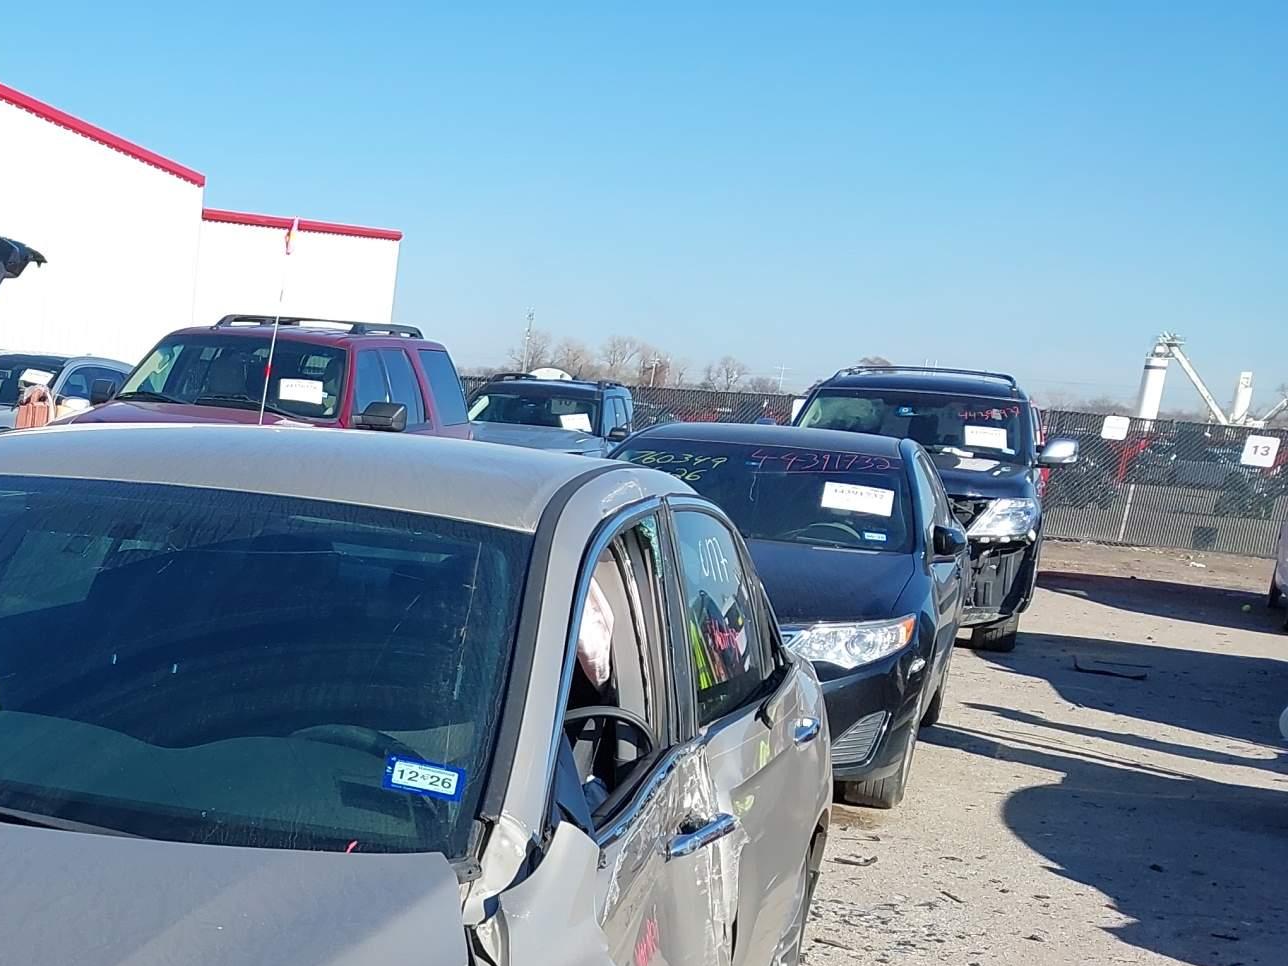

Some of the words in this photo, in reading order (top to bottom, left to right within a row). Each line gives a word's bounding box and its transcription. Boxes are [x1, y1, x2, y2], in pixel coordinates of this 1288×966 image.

[1252, 445, 1271, 456] 13
[397, 769, 420, 782] 12
[428, 775, 453, 789] 26
